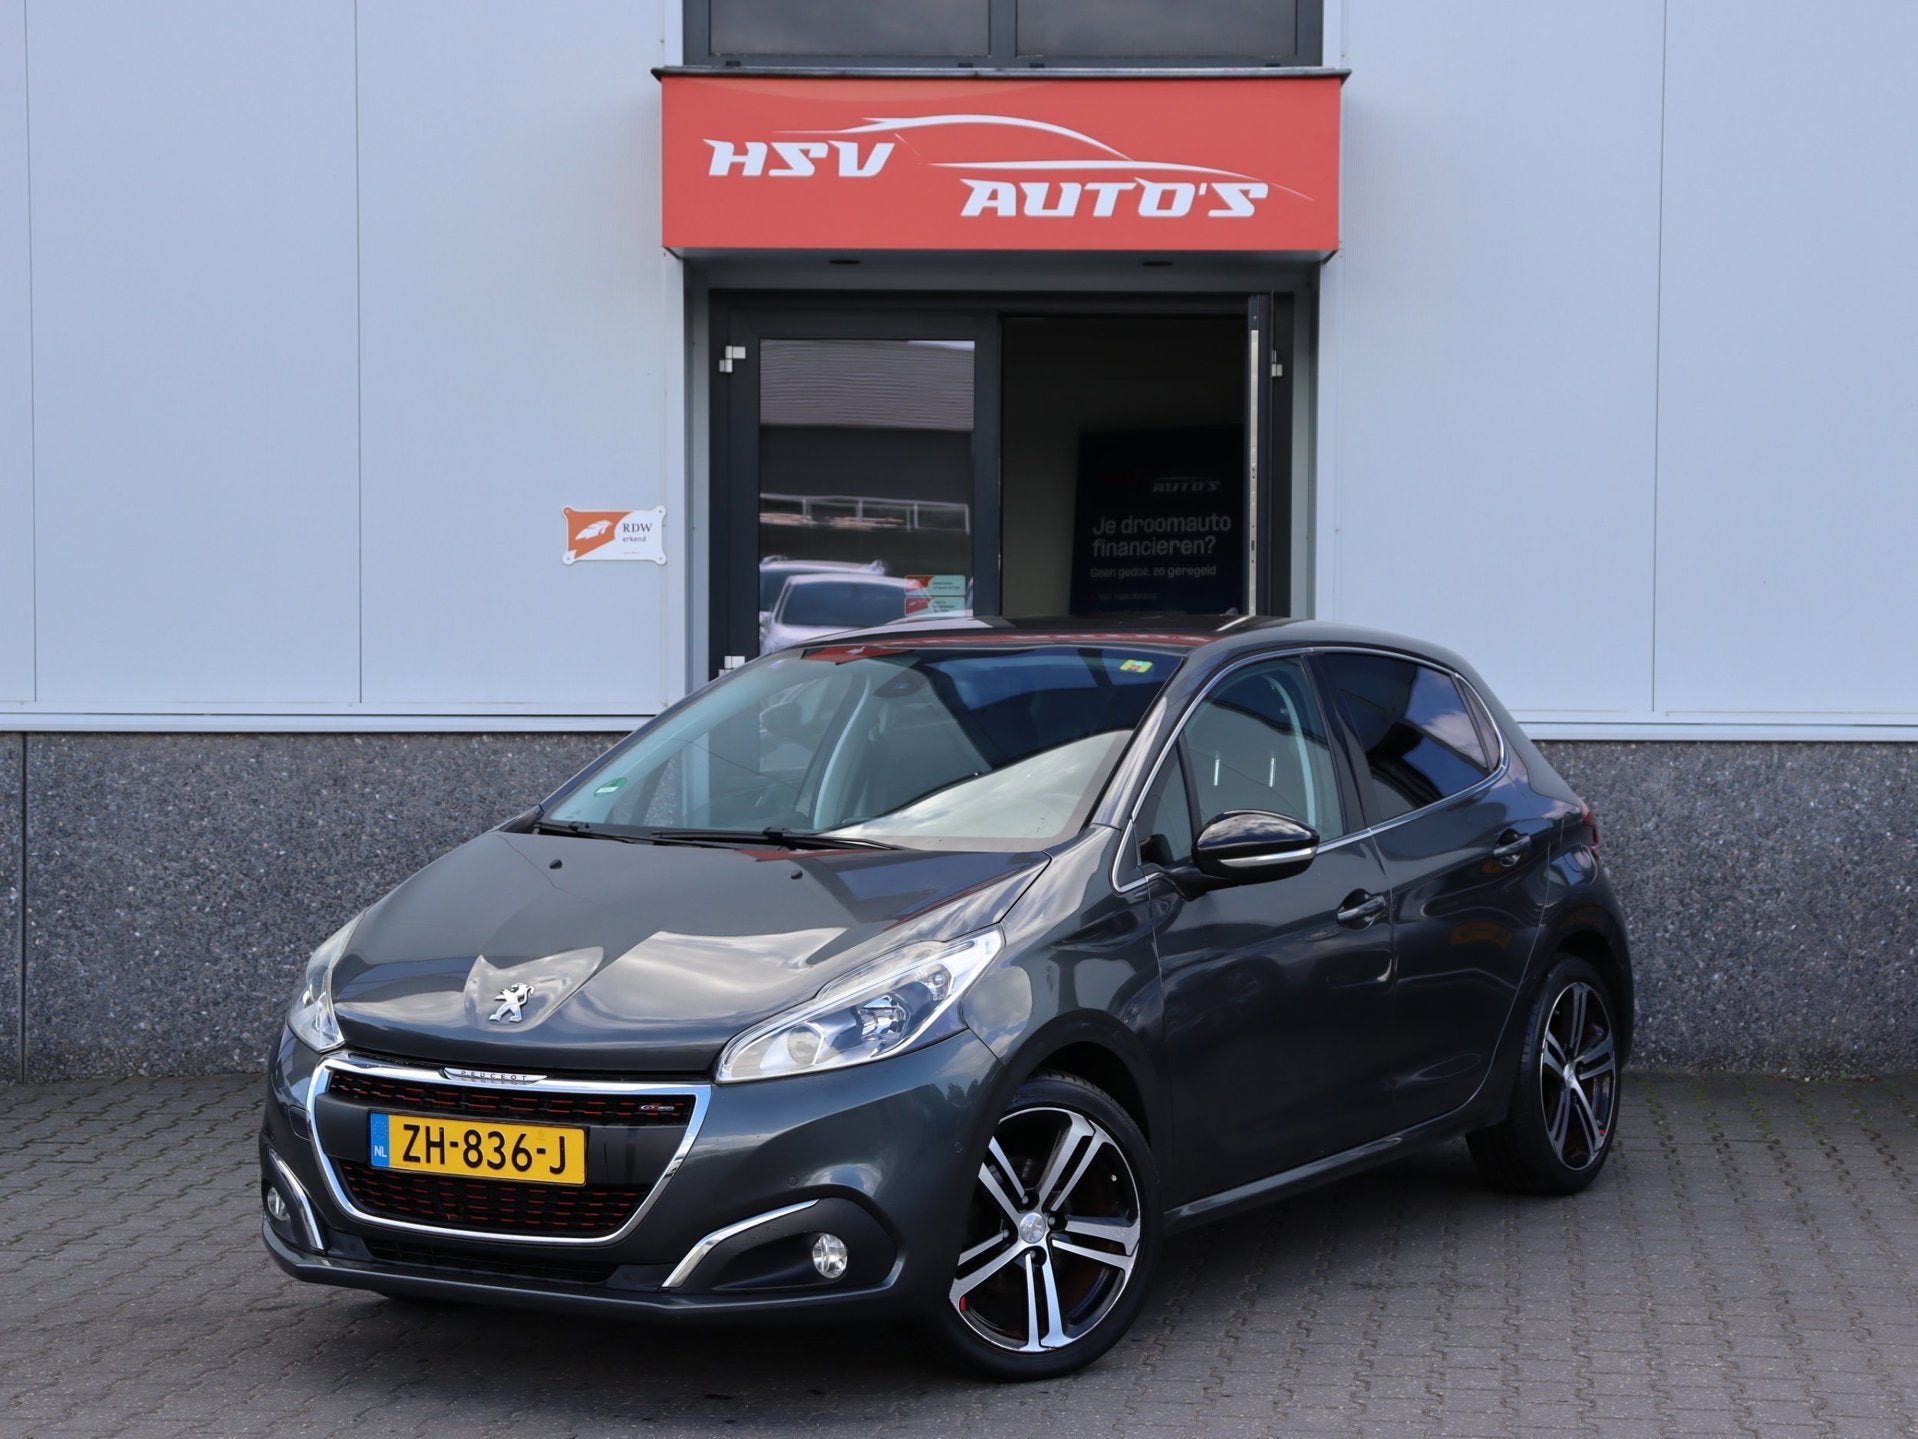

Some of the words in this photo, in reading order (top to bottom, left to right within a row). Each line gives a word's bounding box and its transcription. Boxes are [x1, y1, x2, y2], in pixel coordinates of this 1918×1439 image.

[703, 139, 895, 178] HSV
[961, 178, 1269, 218] AUTO'S
[623, 523, 652, 533] RDW
[1092, 516, 1116, 535] Je
[1121, 513, 1231, 534] droomauto
[1092, 536, 1216, 557] financieren?
[1090, 567, 1116, 578] Geen
[1153, 567, 1165, 577] zo
[1167, 565, 1216, 579] geregeld
[461, 1071, 527, 1081] PEUGEOT
[374, 1144, 387, 1157] NL
[402, 1124, 567, 1175] ZH-836-J
